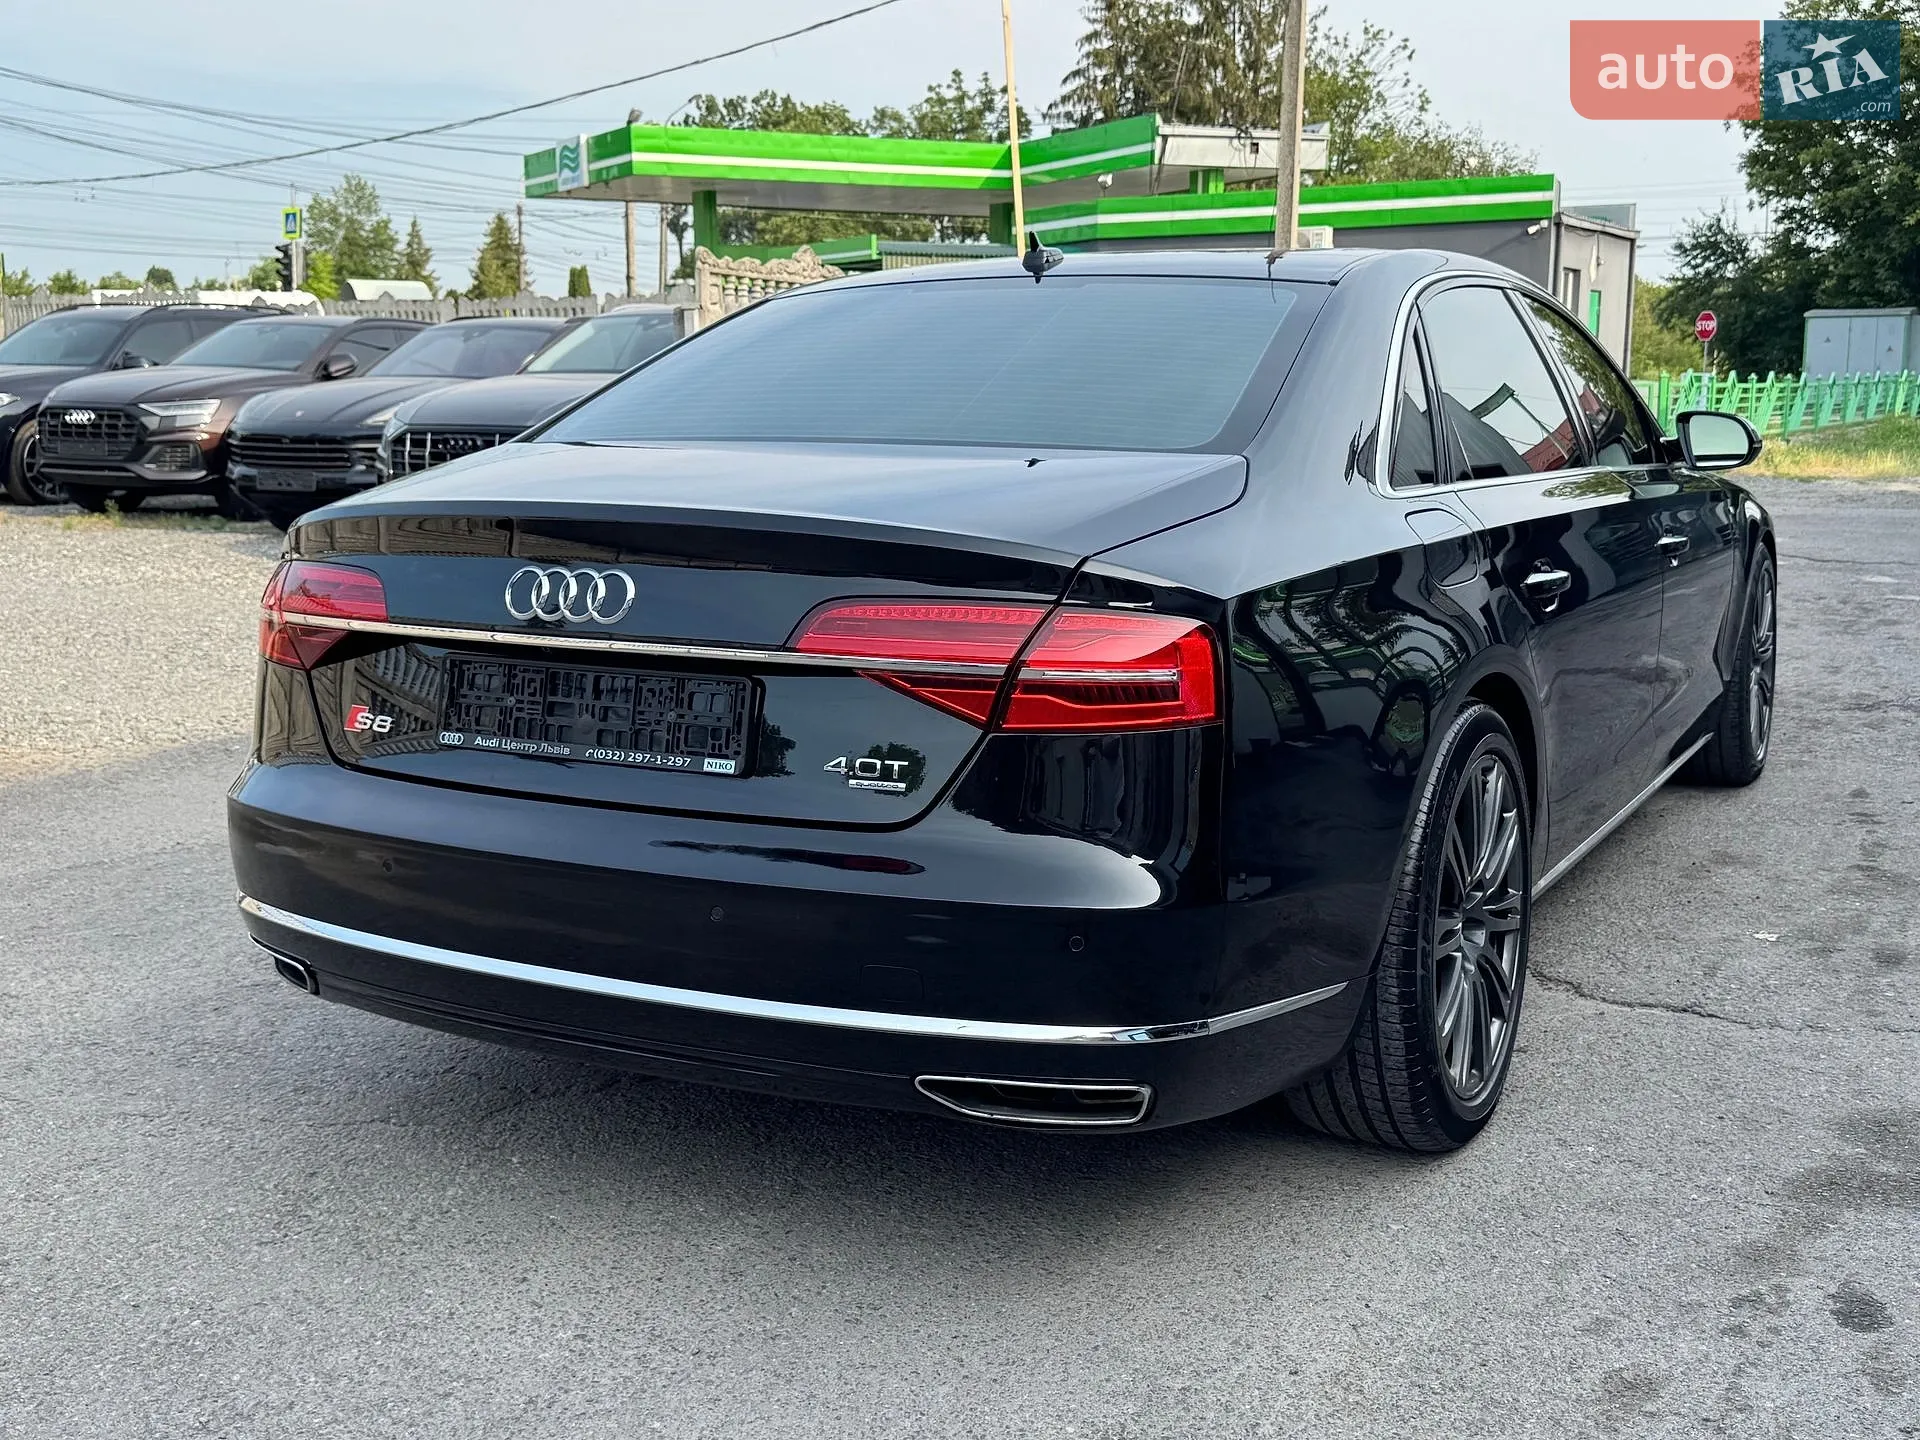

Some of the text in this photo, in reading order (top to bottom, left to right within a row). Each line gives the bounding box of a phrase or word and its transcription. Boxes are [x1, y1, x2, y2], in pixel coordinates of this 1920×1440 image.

[1696, 320, 1715, 331] STOP
[354, 711, 393, 733] S8
[474, 736, 571, 755] Audi Центр Львів
[593, 749, 692, 767] (032) 297-1-297
[705, 760, 733, 771] NIKO
